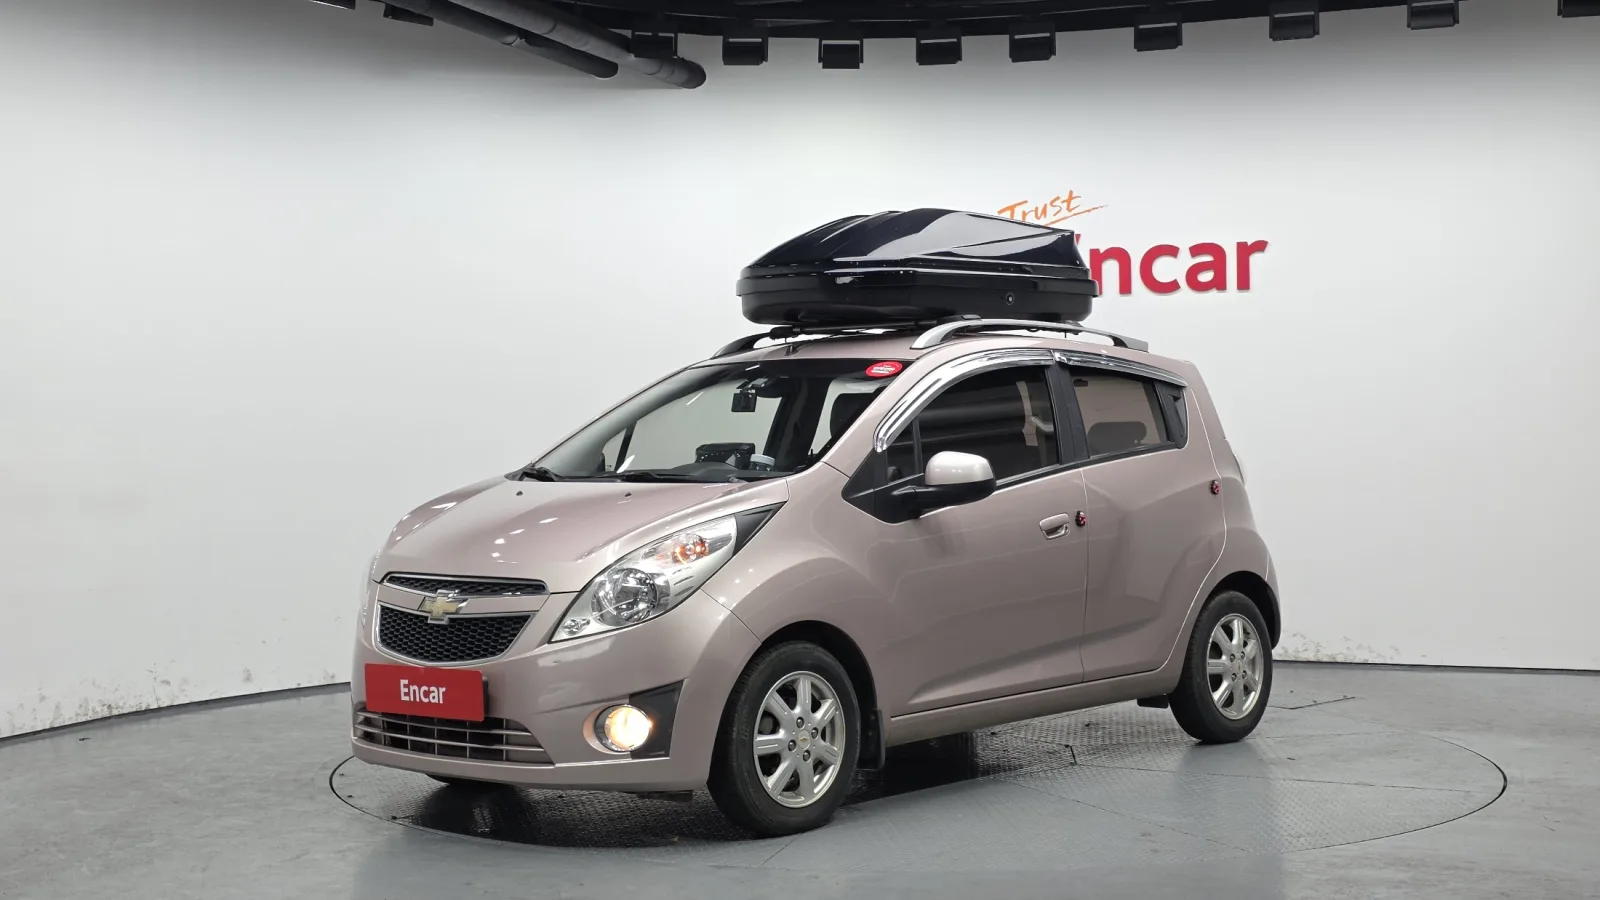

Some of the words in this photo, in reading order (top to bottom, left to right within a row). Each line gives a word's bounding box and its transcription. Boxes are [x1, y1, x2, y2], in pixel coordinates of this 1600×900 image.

[997, 189, 1082, 222] Trust
[1075, 234, 1269, 296] ncar
[399, 679, 446, 704] Encar
